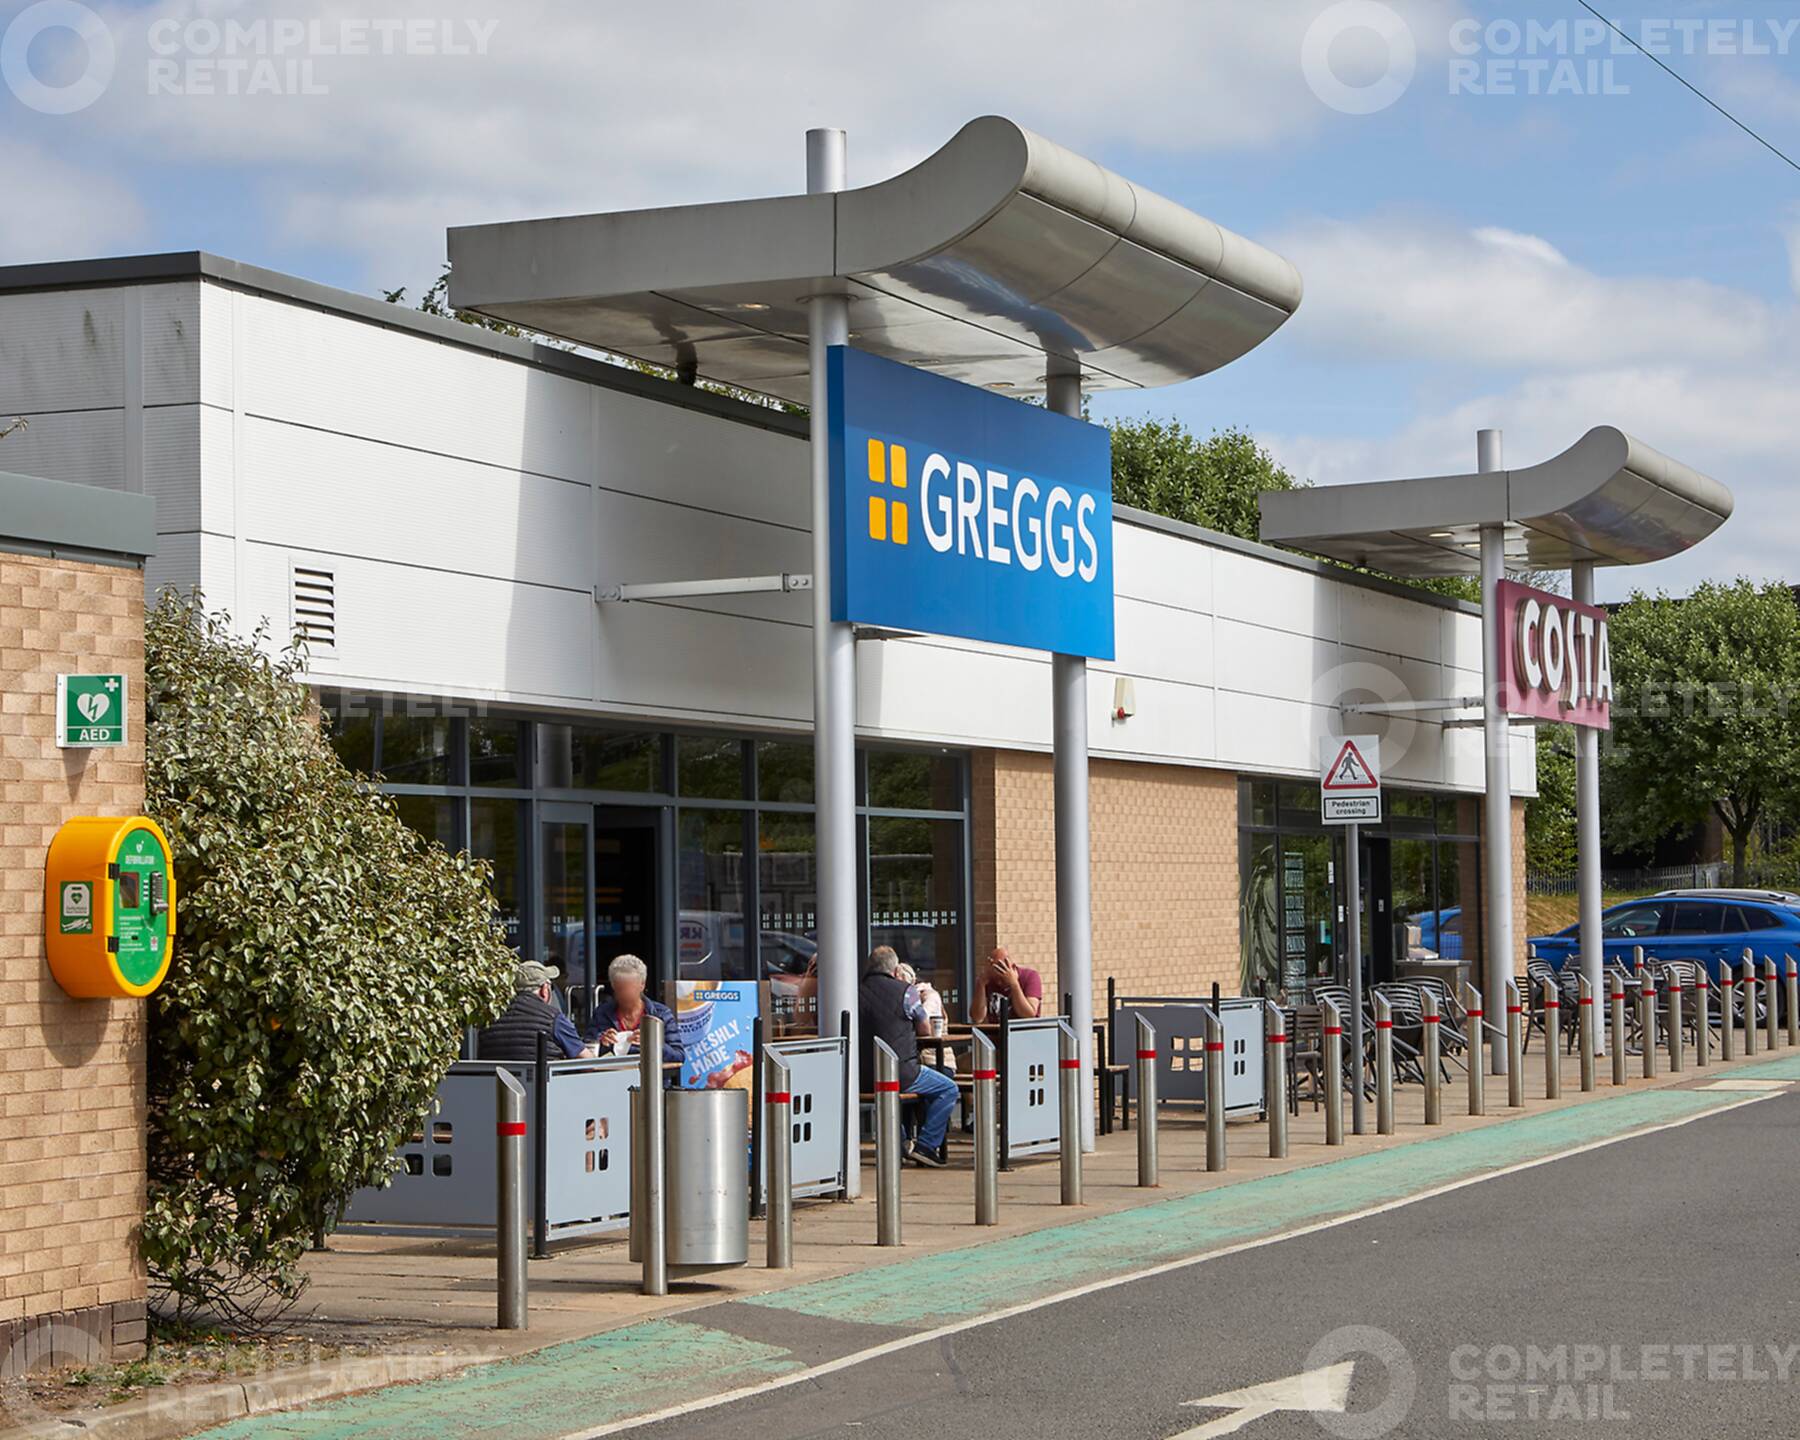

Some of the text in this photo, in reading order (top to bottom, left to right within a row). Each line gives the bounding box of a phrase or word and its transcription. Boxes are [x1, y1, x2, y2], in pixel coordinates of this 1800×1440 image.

[920, 453, 1098, 583] GREGGS
[1520, 598, 1614, 710] COSTA
[79, 728, 110, 741] AED
[1331, 799, 1370, 807] Pedestrian
[1336, 807, 1366, 815] crossing
[704, 991, 739, 1000] GREGGS
[684, 1019, 741, 1061] FRESHLY
[691, 1044, 731, 1076] MADE
